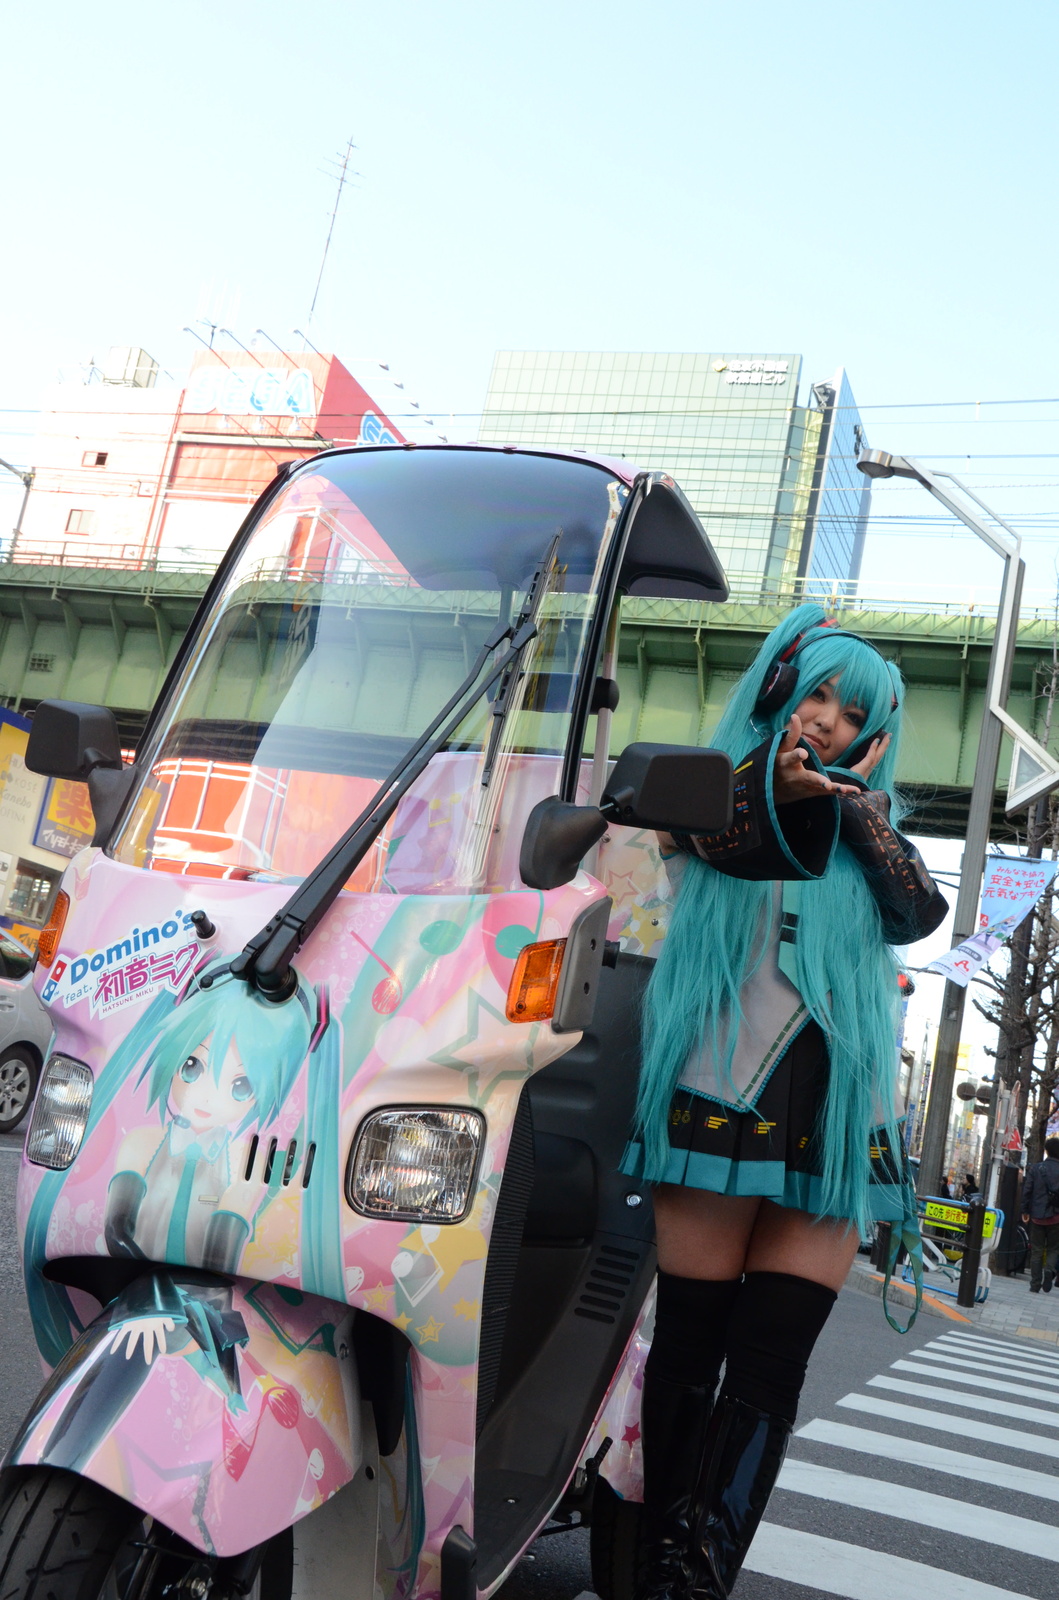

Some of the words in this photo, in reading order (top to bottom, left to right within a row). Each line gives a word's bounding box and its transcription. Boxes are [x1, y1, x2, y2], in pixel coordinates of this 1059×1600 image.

[183, 367, 315, 416] SEGA
[71, 909, 195, 985] Domino's
[65, 984, 93, 1005] feat.
[94, 942, 199, 1003] 初音ミク
[102, 995, 134, 1014] HATSUNE
[135, 986, 155, 999] MIKU
